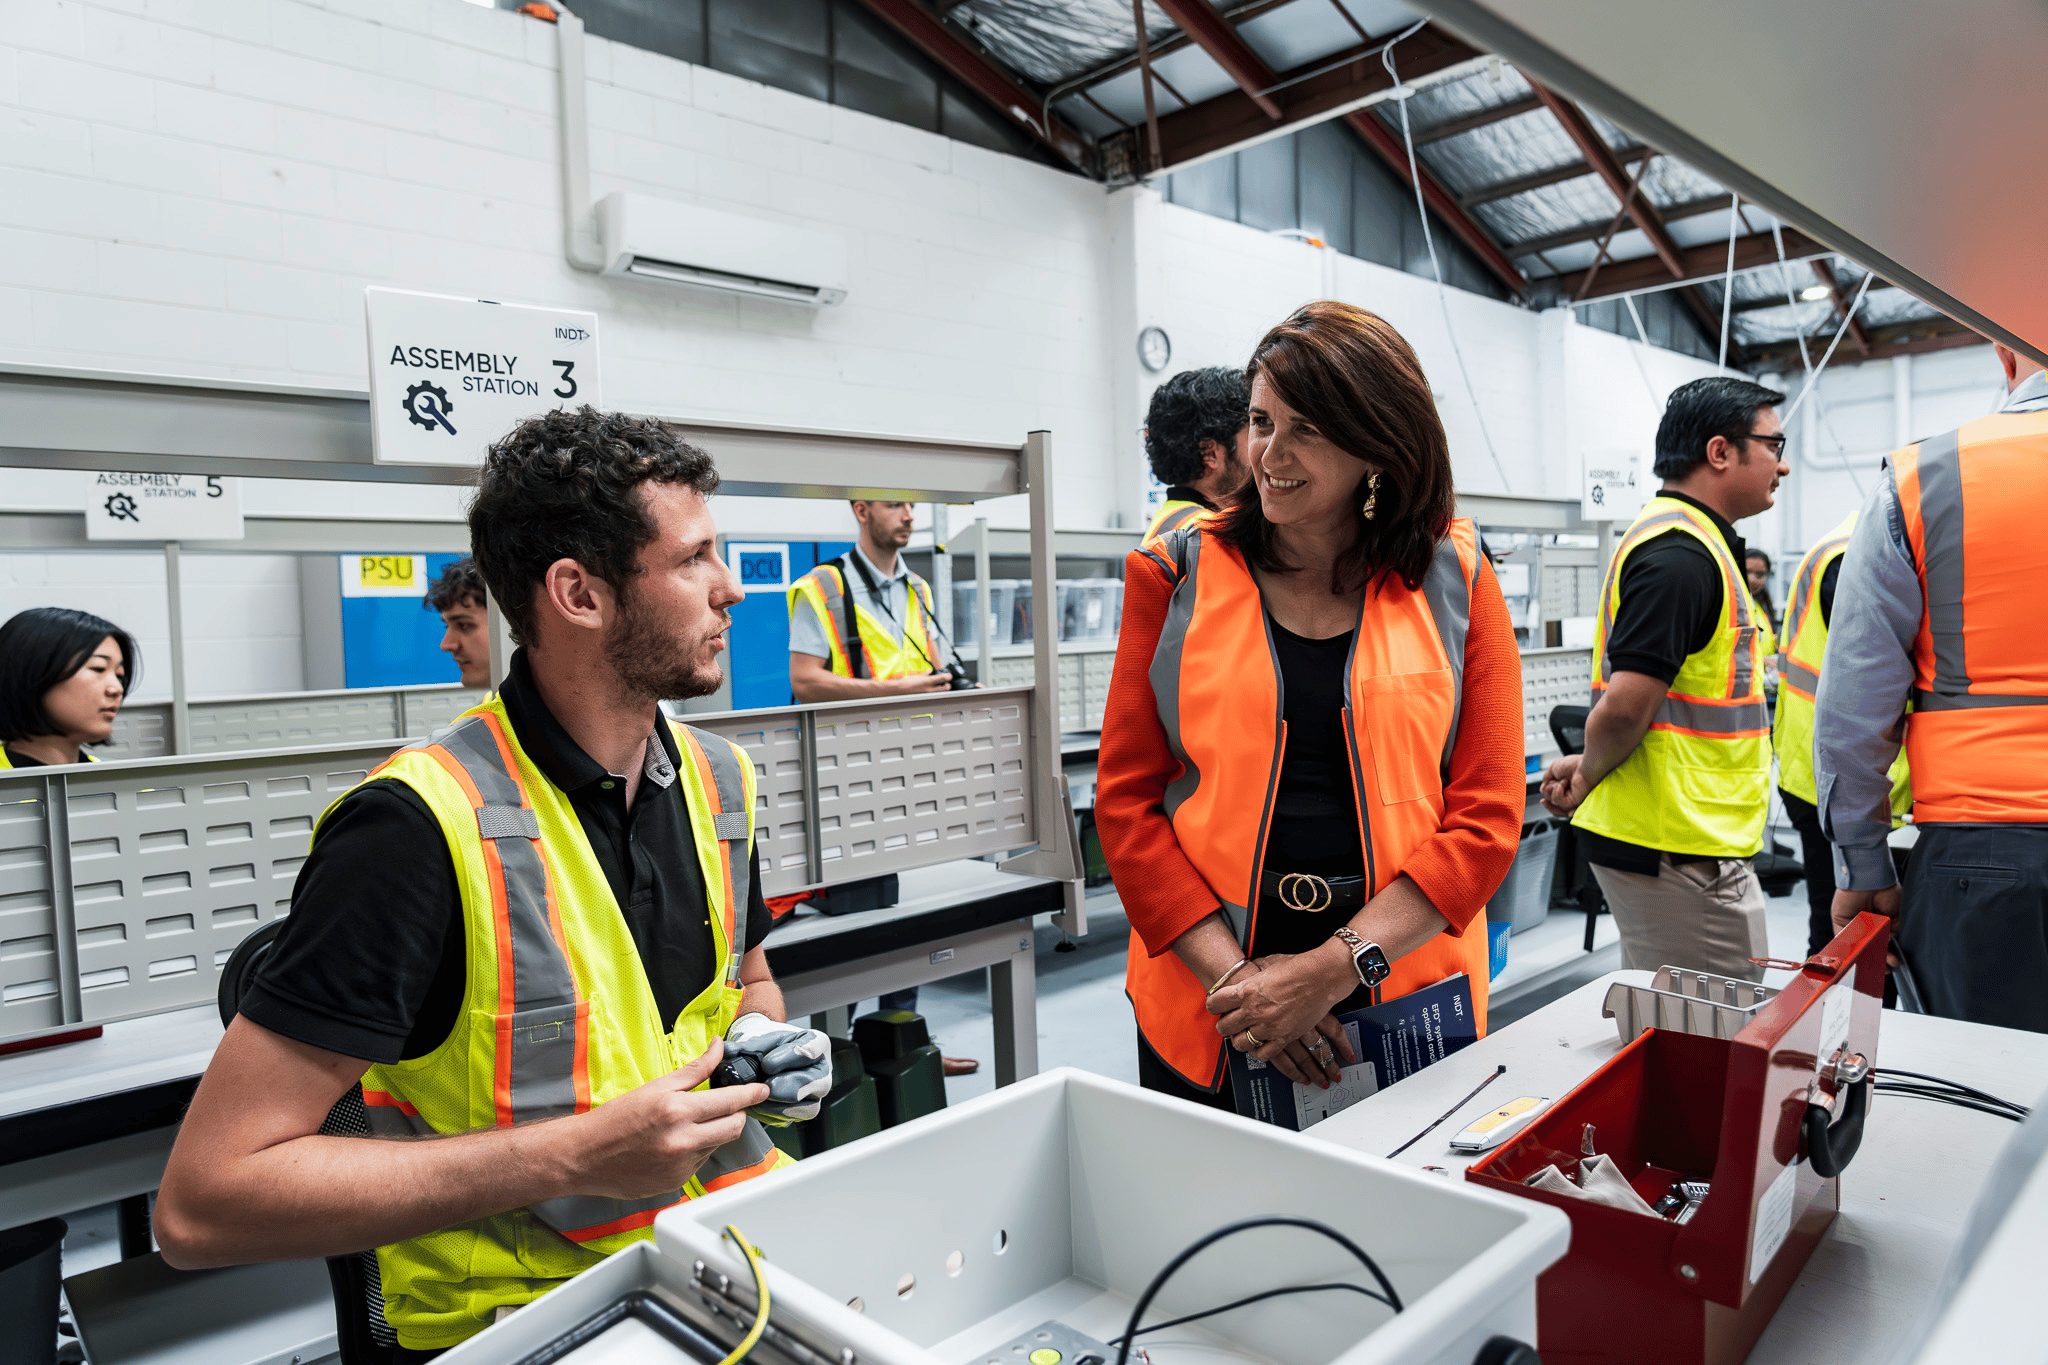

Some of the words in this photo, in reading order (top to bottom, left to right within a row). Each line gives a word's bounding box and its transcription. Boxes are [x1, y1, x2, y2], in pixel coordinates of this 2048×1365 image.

[555, 327, 584, 340] INDT
[390, 345, 518, 375] ASSEMBLY
[552, 360, 577, 399] 3
[463, 376, 539, 396] STATION
[97, 474, 182, 486] ASSEMBLY
[206, 476, 223, 498] 5
[1628, 471, 1635, 488] 4
[144, 488, 196, 498] STATION
[362, 558, 413, 580] PSU
[742, 559, 782, 579] DCU
[1453, 994, 1464, 1017] INDT
[1422, 1008, 1434, 1042] optional
[1434, 1025, 1445, 1058] systems
